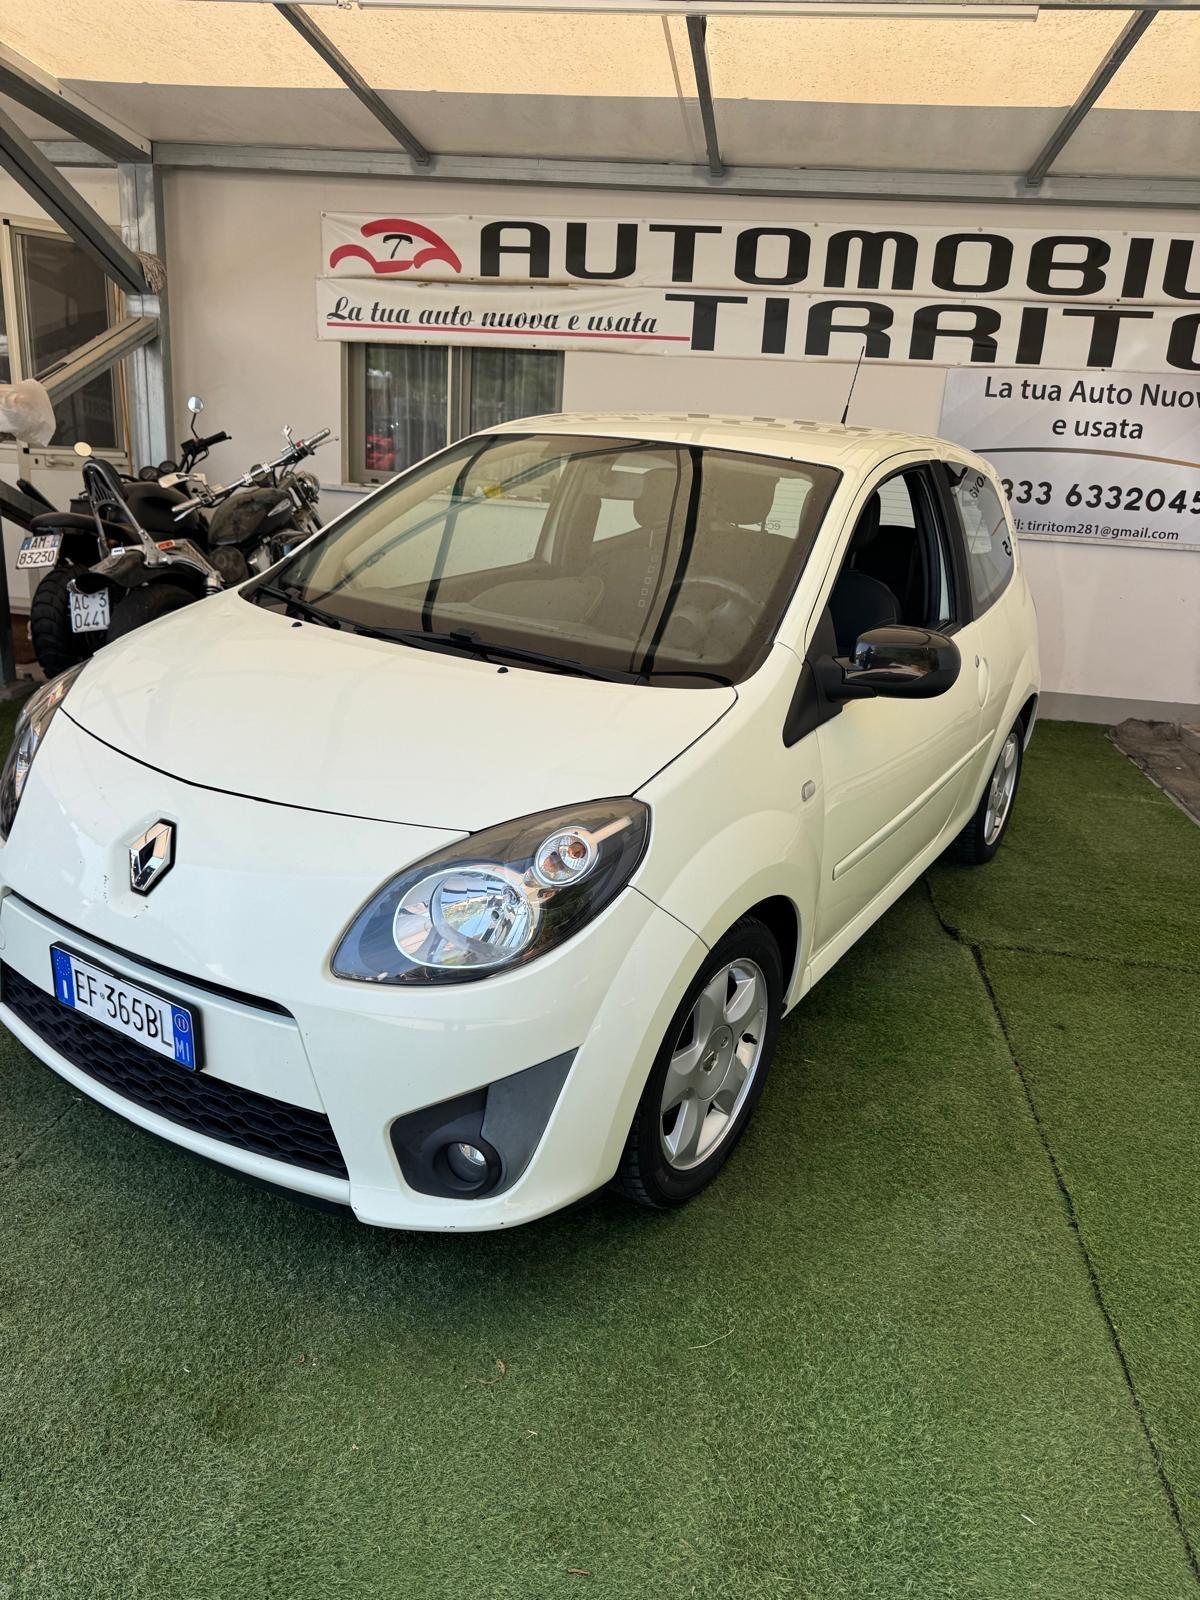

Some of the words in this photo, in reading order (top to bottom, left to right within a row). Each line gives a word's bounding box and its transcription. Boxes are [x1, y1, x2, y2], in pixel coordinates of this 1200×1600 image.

[327, 296, 363, 321] La
[370, 301, 411, 324] tua
[418, 305, 475, 326] auto
[480, 312, 560, 330] nuova
[567, 314, 580, 331] e
[587, 311, 658, 334] usata
[985, 376, 1012, 399] La
[1021, 379, 1062, 402] tua
[1069, 380, 1133, 405] Auto
[1052, 419, 1067, 436] e
[1074, 418, 1144, 439] usata
[1027, 520, 1179, 541] tirritom281@gmail.com
[19, 551, 55, 565] 83230
[74, 595, 89, 611] AC
[99, 592, 107, 607] 3
[74, 611, 107, 629] 0441
[74, 969, 98, 1007] EF
[104, 984, 172, 1048] 365BL
[175, 1037, 191, 1062] MI
